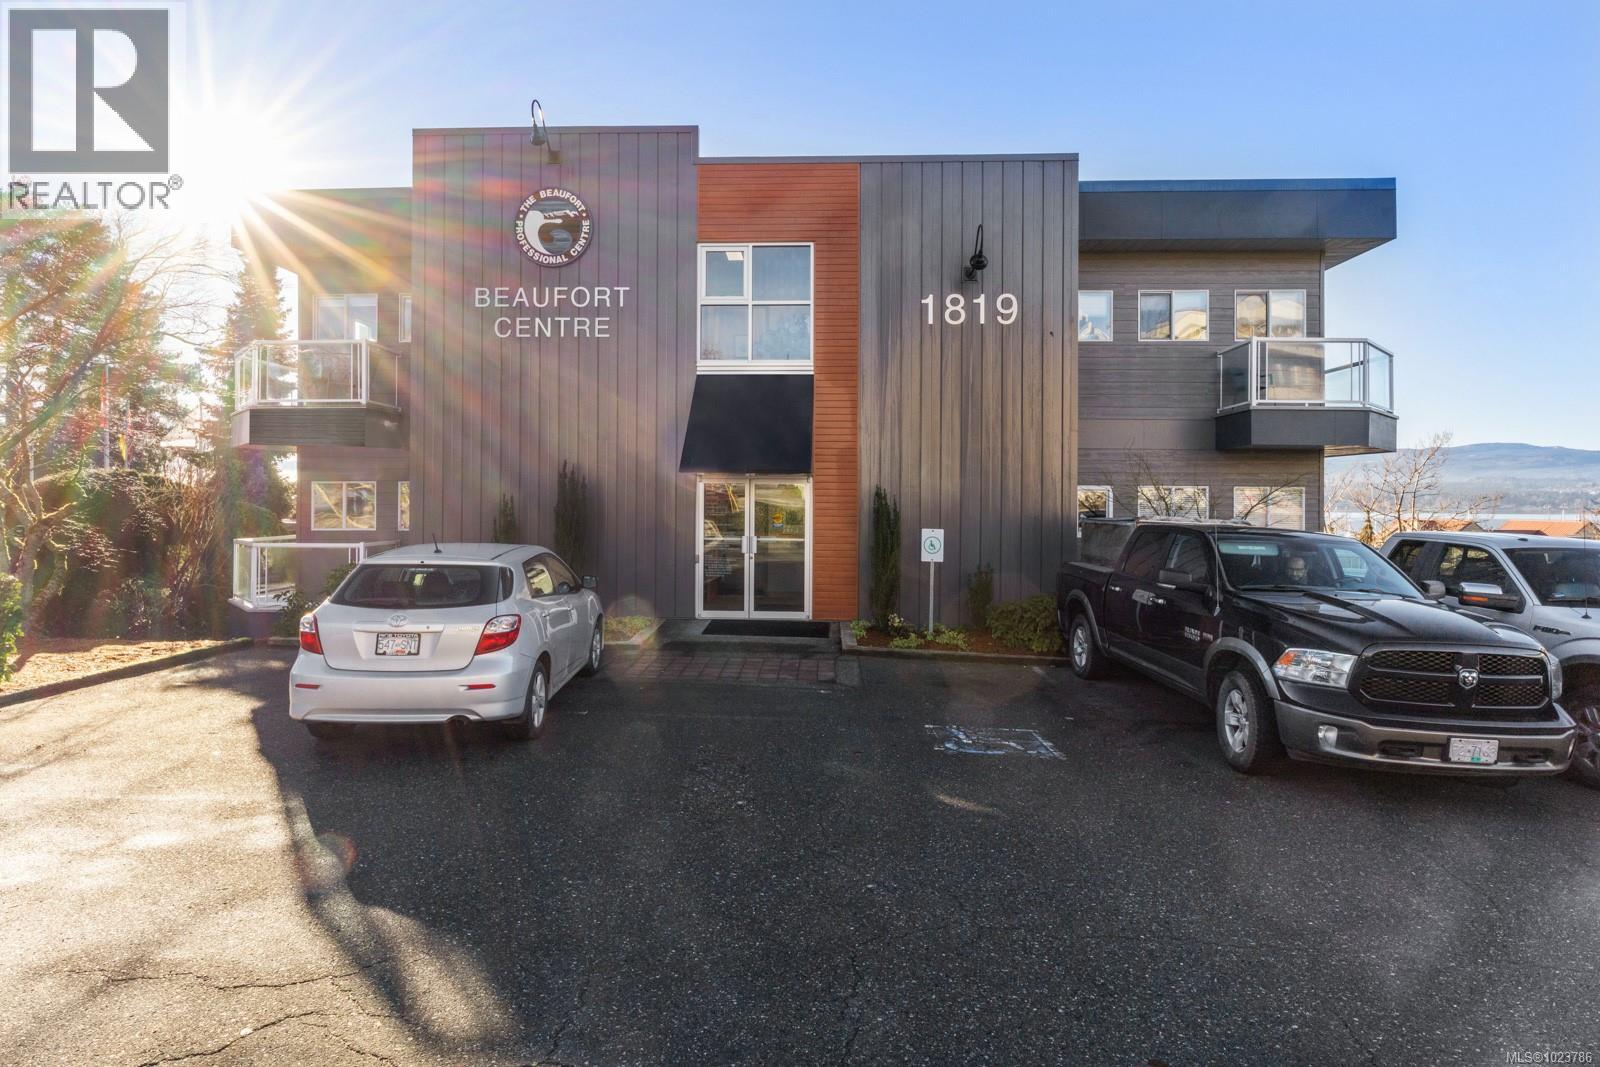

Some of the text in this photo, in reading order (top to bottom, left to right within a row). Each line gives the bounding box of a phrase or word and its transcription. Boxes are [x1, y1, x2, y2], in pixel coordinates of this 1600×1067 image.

[520, 188, 586, 214] THE BEAUFORT
[515, 219, 590, 264] PROFESSIONAL CENTRE
[474, 286, 631, 308] BEAUFORT
[921, 293, 1018, 325] 1819
[494, 316, 611, 338] CENTRE
